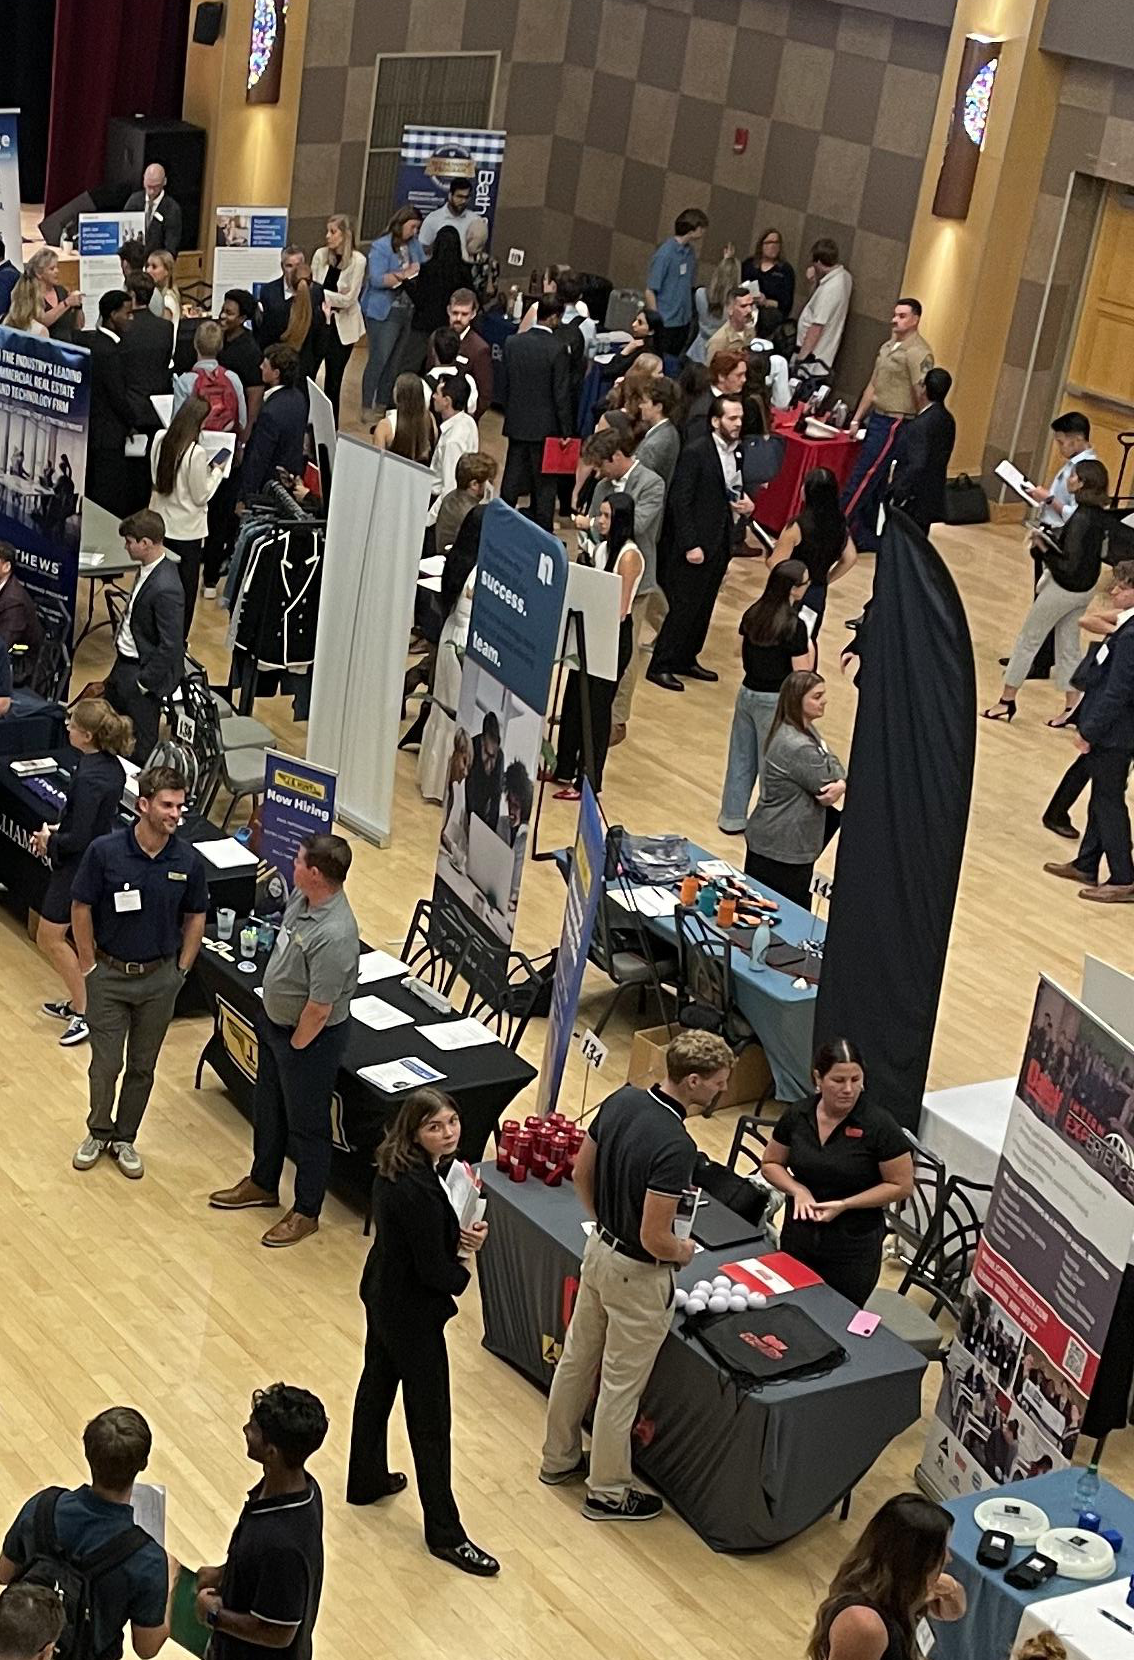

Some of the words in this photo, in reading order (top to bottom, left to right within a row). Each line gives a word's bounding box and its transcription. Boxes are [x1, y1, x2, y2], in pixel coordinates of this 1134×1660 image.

[2, 349, 15, 365] THE
[15, 353, 53, 375] INDUSTRY'S
[53, 364, 82, 384] LEADING
[11, 385, 52, 409] TECHNOLOGY
[52, 397, 69, 414] FIRM
[33, 375, 50, 392] REAL
[51, 380, 75, 399] ESTATE
[481, 570, 527, 617] success.
[472, 630, 501, 668] team.
[267, 788, 293, 807] Now
[294, 798, 330, 822] Hiring
[582, 1038, 603, 1068] 134
